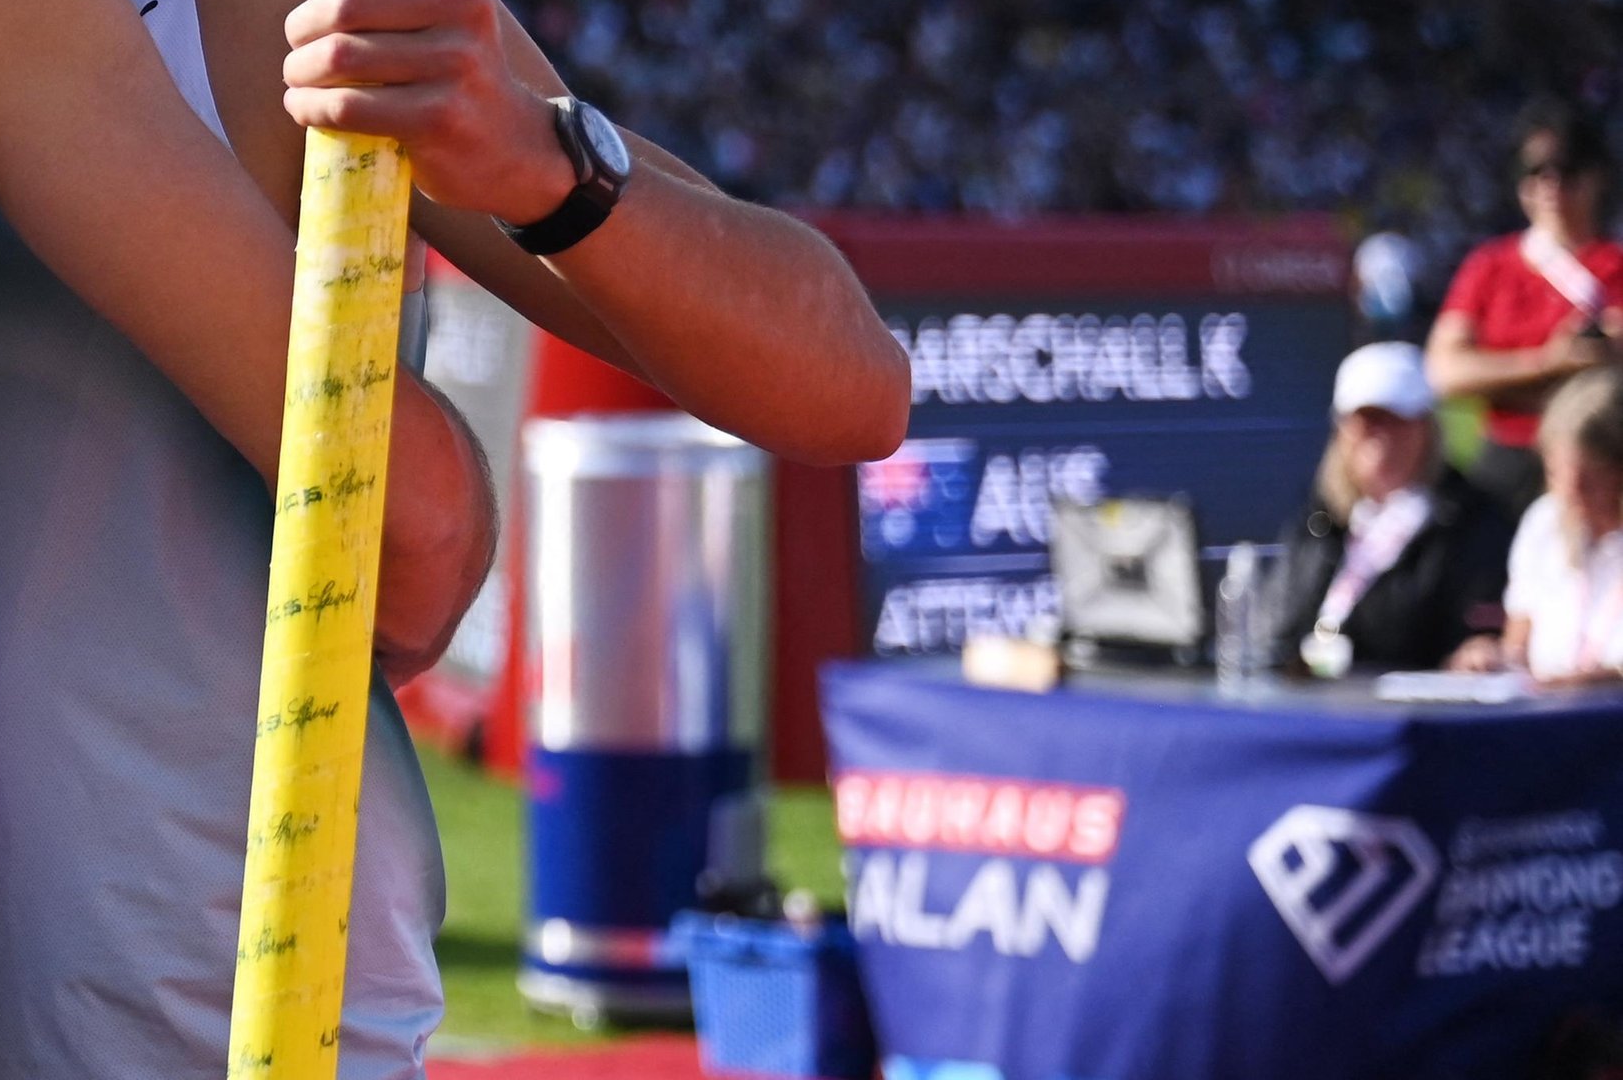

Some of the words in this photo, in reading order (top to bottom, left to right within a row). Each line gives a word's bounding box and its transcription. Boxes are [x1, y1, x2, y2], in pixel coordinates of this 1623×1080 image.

[888, 313, 1201, 404] ARSCHALL
[1200, 312, 1253, 400] K
[842, 849, 1111, 965] ALAN
